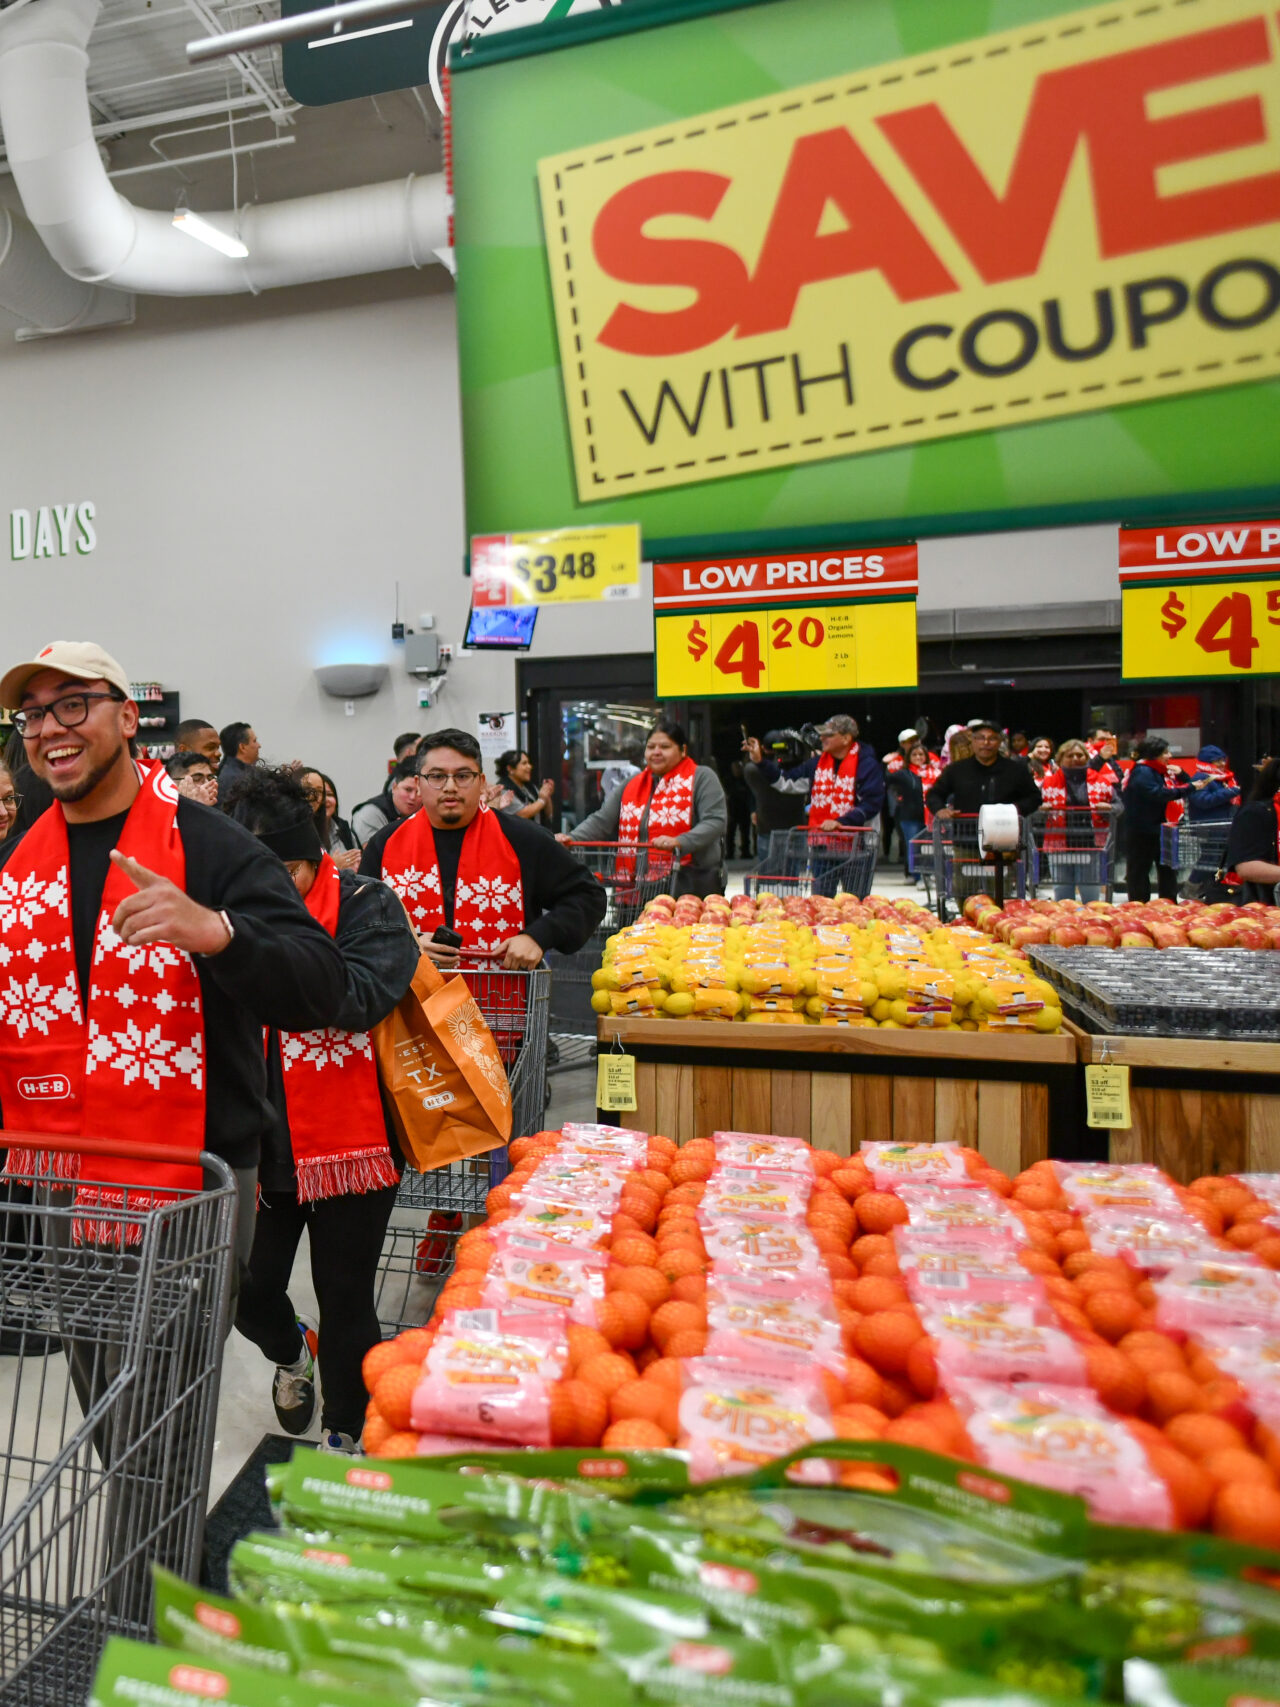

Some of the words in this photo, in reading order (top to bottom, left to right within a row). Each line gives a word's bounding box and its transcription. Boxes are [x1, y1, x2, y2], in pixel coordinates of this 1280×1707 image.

[591, 14, 1280, 357] SAVE
[620, 342, 856, 446] WITH
[10, 501, 97, 560] DAYS
[1156, 529, 1250, 559] LOW
[683, 564, 758, 590] LOW
[766, 555, 885, 585] PRICES
[828, 623, 853, 631] Organic
[23, 1080, 64, 1094] H-E-B
[406, 1062, 443, 1084] TX
